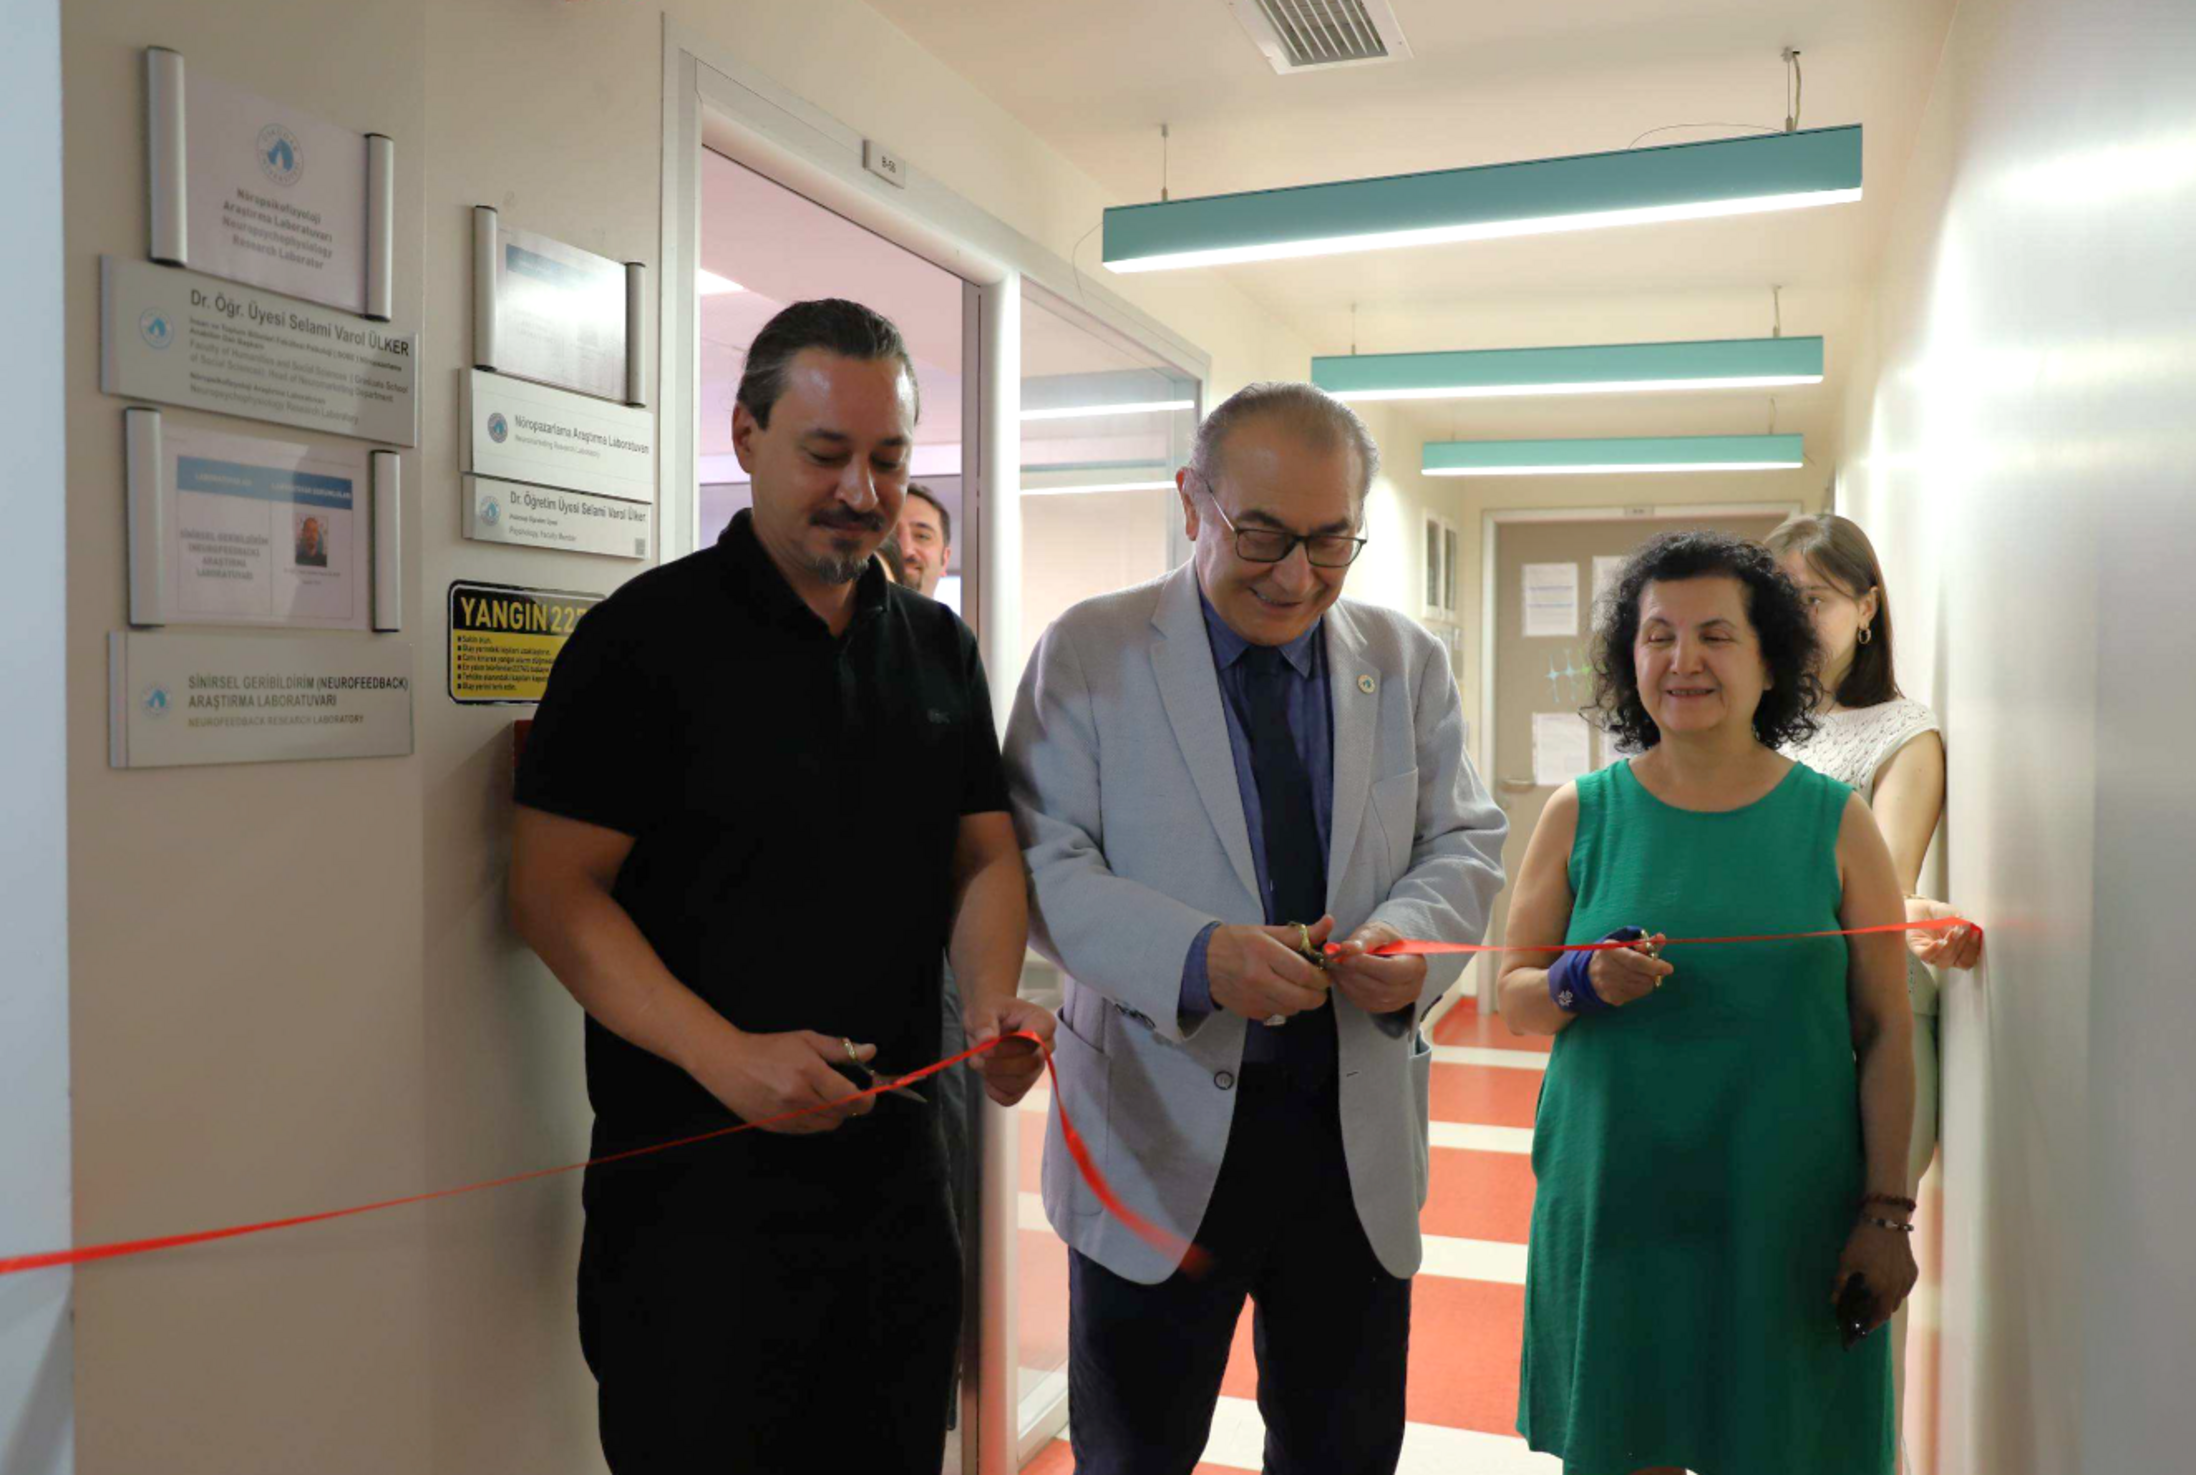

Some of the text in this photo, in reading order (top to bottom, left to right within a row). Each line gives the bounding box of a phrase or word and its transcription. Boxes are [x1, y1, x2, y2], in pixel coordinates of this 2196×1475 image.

[223, 200, 272, 224] Araştırma
[232, 233, 277, 256] Research
[190, 288, 409, 357] Dr. Öğr. Üyesi Selami Varol ÜLKER
[515, 415, 571, 437] Nöropazarlama
[572, 428, 607, 445] Araştırma
[510, 491, 521, 505] Dr.
[523, 491, 556, 510] Öğretim
[581, 502, 607, 517] Selami
[461, 597, 547, 632] YANGIN
[188, 673, 409, 692] SİNİRSEL GERİBİLDİRİM (NEUROFEEDBACK)
[188, 693, 337, 711] ARAŞTIRMA LABORATUVARI
[188, 714, 364, 727] NEUROFEEDBACK RESEARCH LABORATORY
